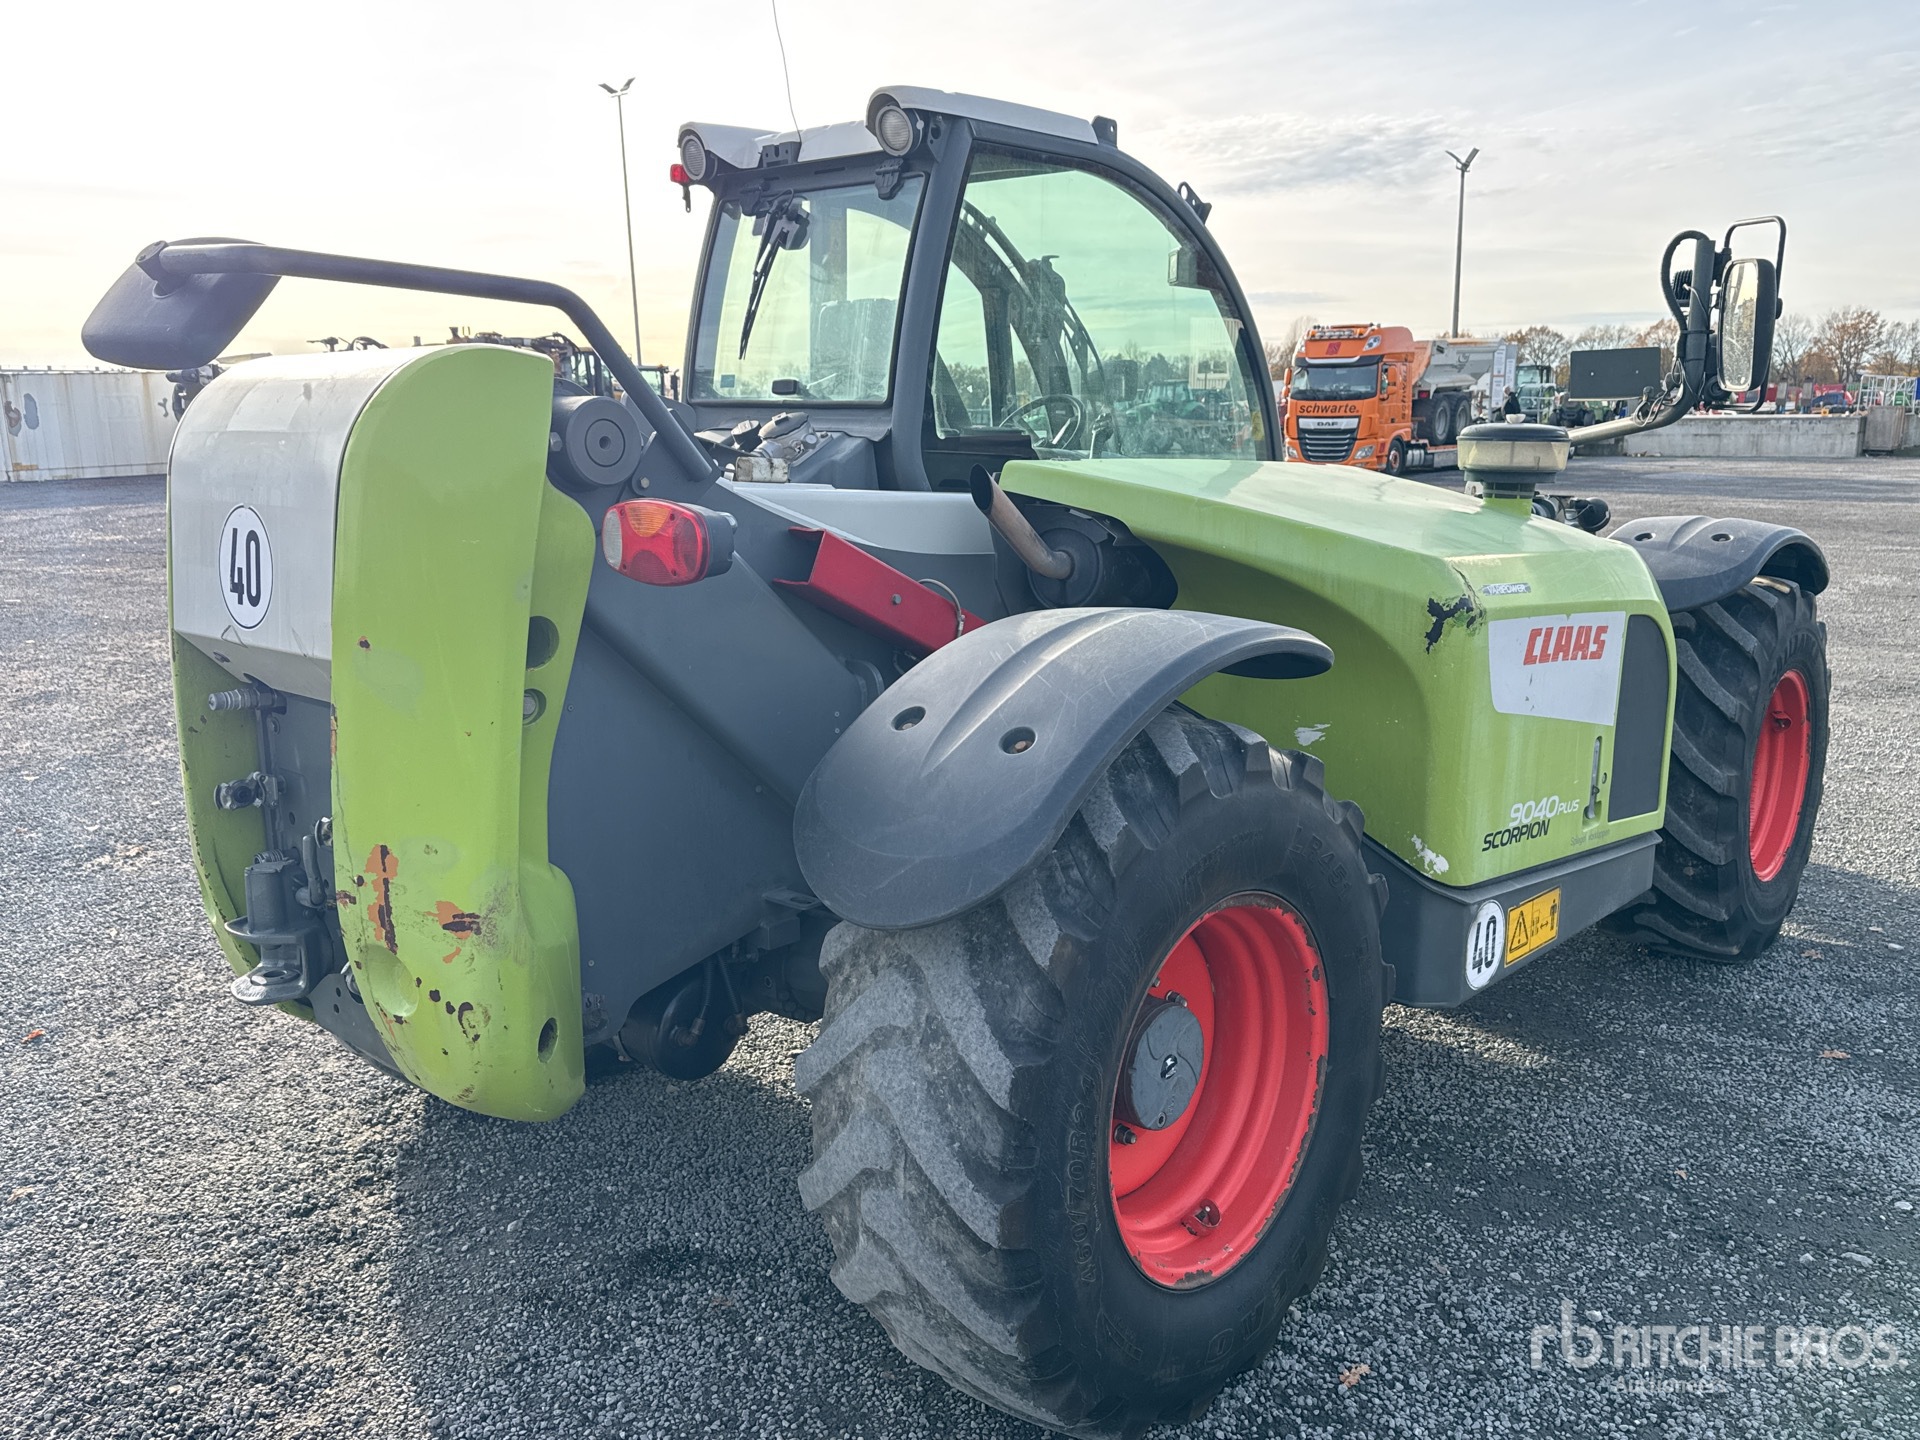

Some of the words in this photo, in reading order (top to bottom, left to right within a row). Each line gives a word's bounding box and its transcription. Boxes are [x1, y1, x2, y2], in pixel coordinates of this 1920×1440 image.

[229, 527, 262, 608] 40
[1523, 625, 1609, 666] CLAAS
[1508, 795, 1560, 828] 9040
[1557, 799, 1580, 816] PLUS
[1481, 818, 1551, 852] SCORPION
[1471, 914, 1497, 975] 40
